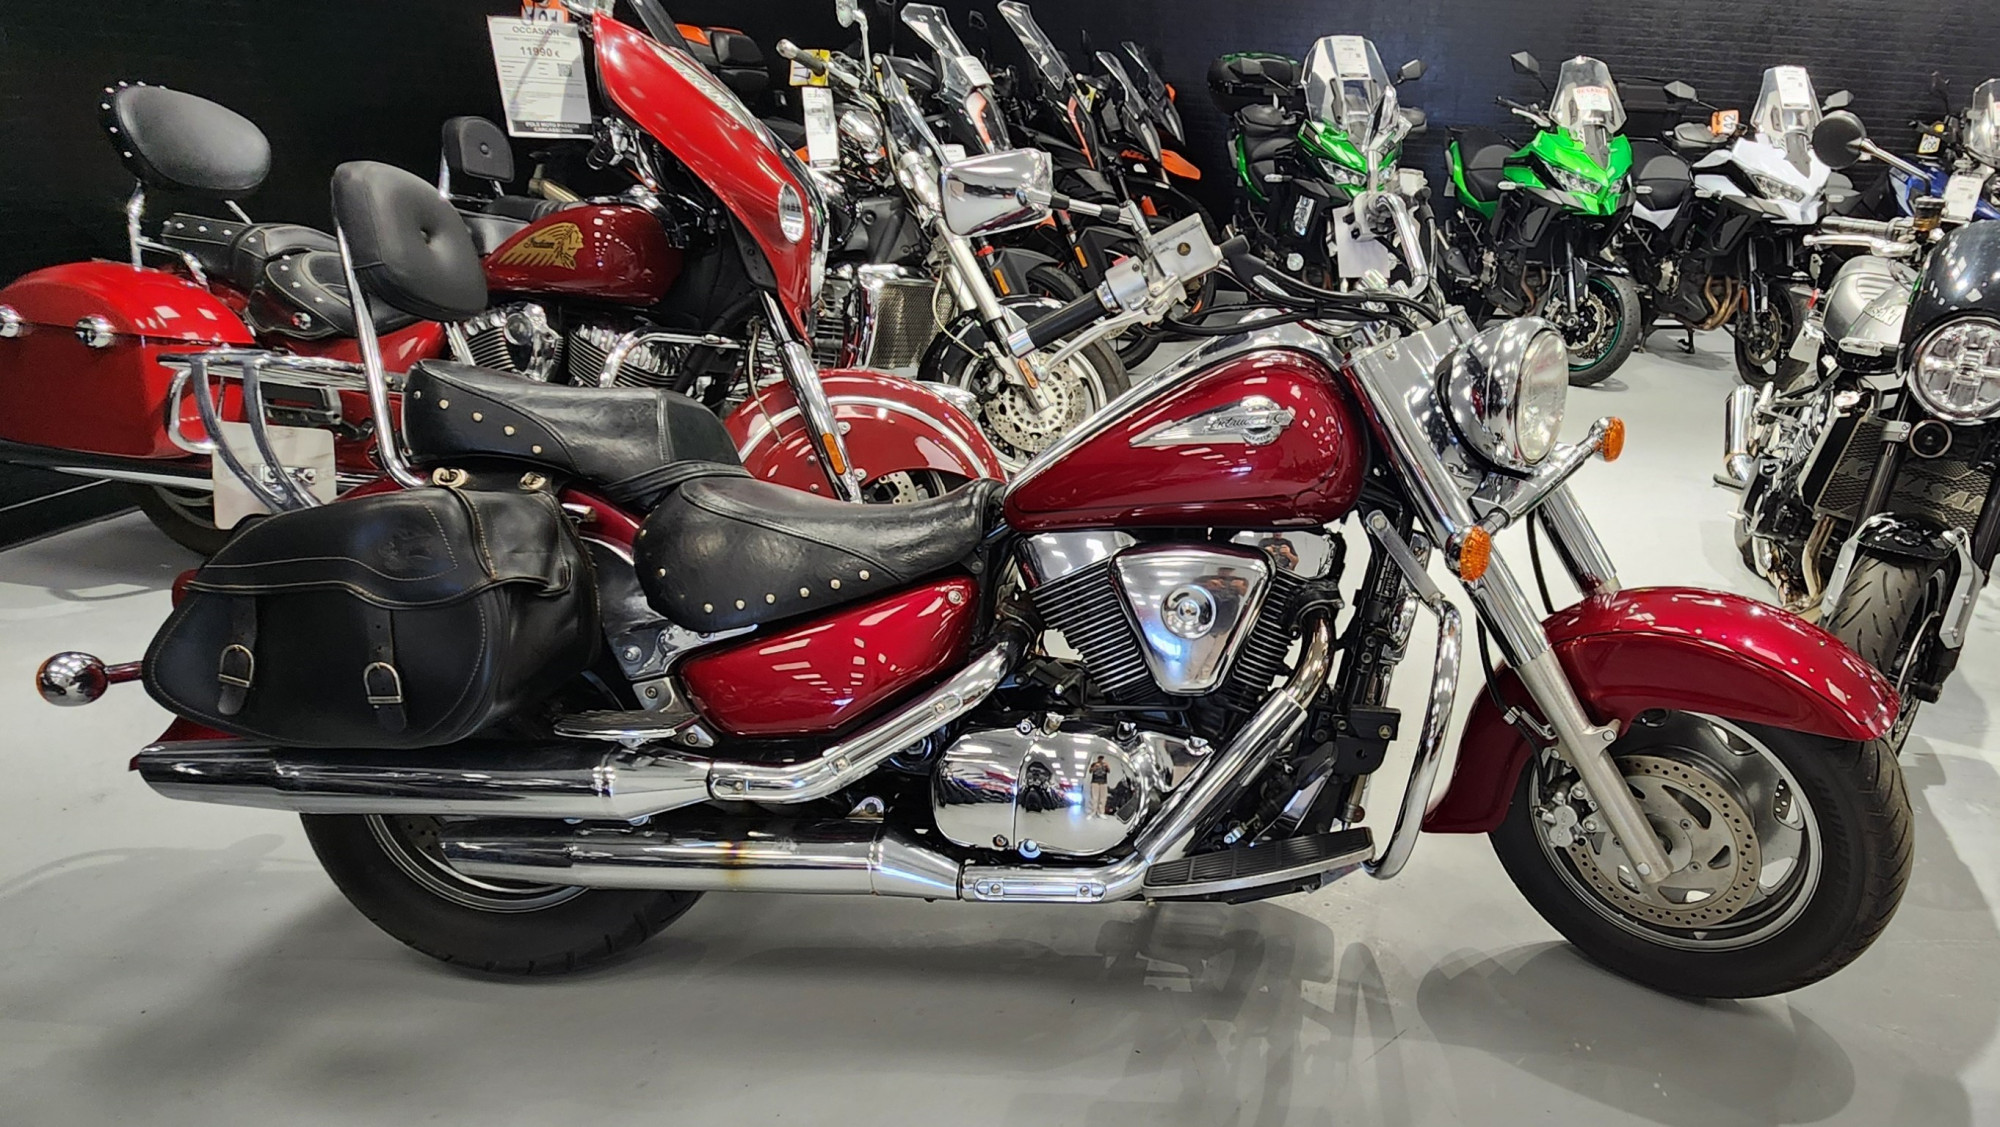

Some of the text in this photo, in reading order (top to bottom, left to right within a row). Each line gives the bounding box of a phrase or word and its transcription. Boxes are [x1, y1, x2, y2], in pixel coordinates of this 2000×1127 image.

[512, 26, 560, 36] OCCASION
[520, 46, 553, 57] 11990
[1723, 114, 1736, 130] 42
